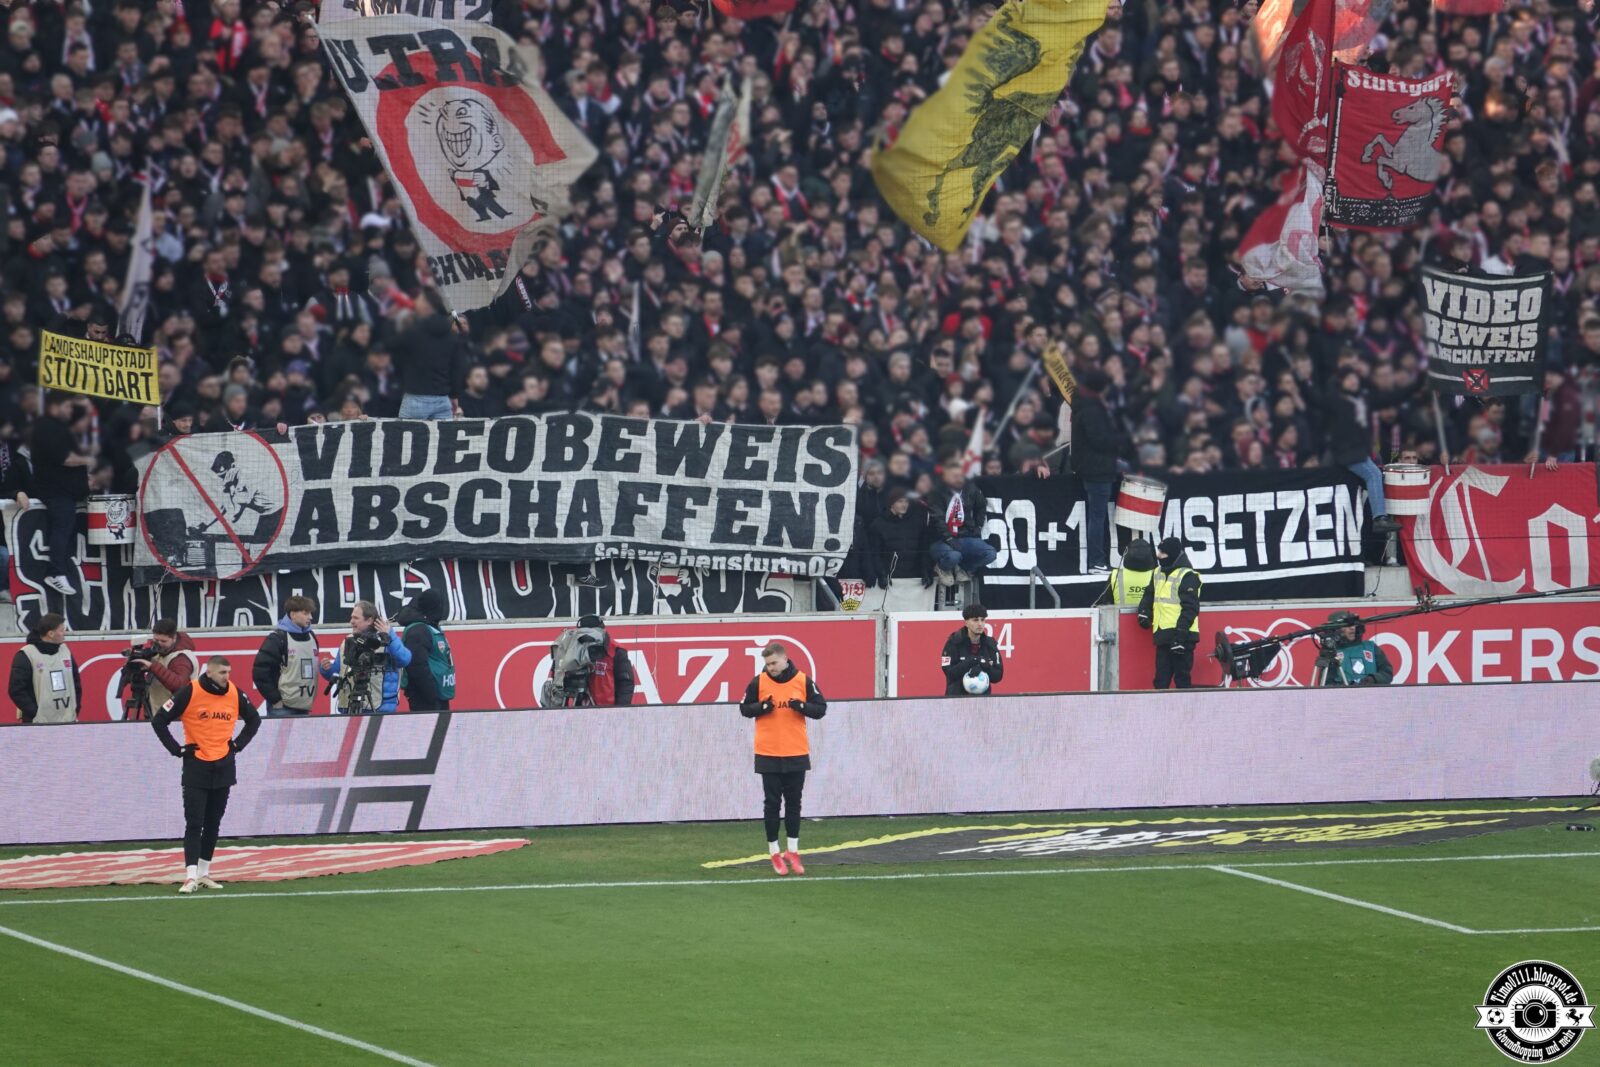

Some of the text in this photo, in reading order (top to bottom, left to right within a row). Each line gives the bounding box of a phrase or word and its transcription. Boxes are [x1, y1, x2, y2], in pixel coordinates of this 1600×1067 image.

[1422, 276, 1542, 324] VIDEO
[44, 335, 153, 369] LANDESHAUPTSTADT
[42, 355, 153, 401] STUTTGART
[294, 416, 853, 488] VIDEOBEWEIS
[290, 478, 847, 552] ABSCHAFFEN!
[52, 697, 70, 710] TV
[299, 685, 315, 698] TV
[211, 711, 232, 721] JAKO
